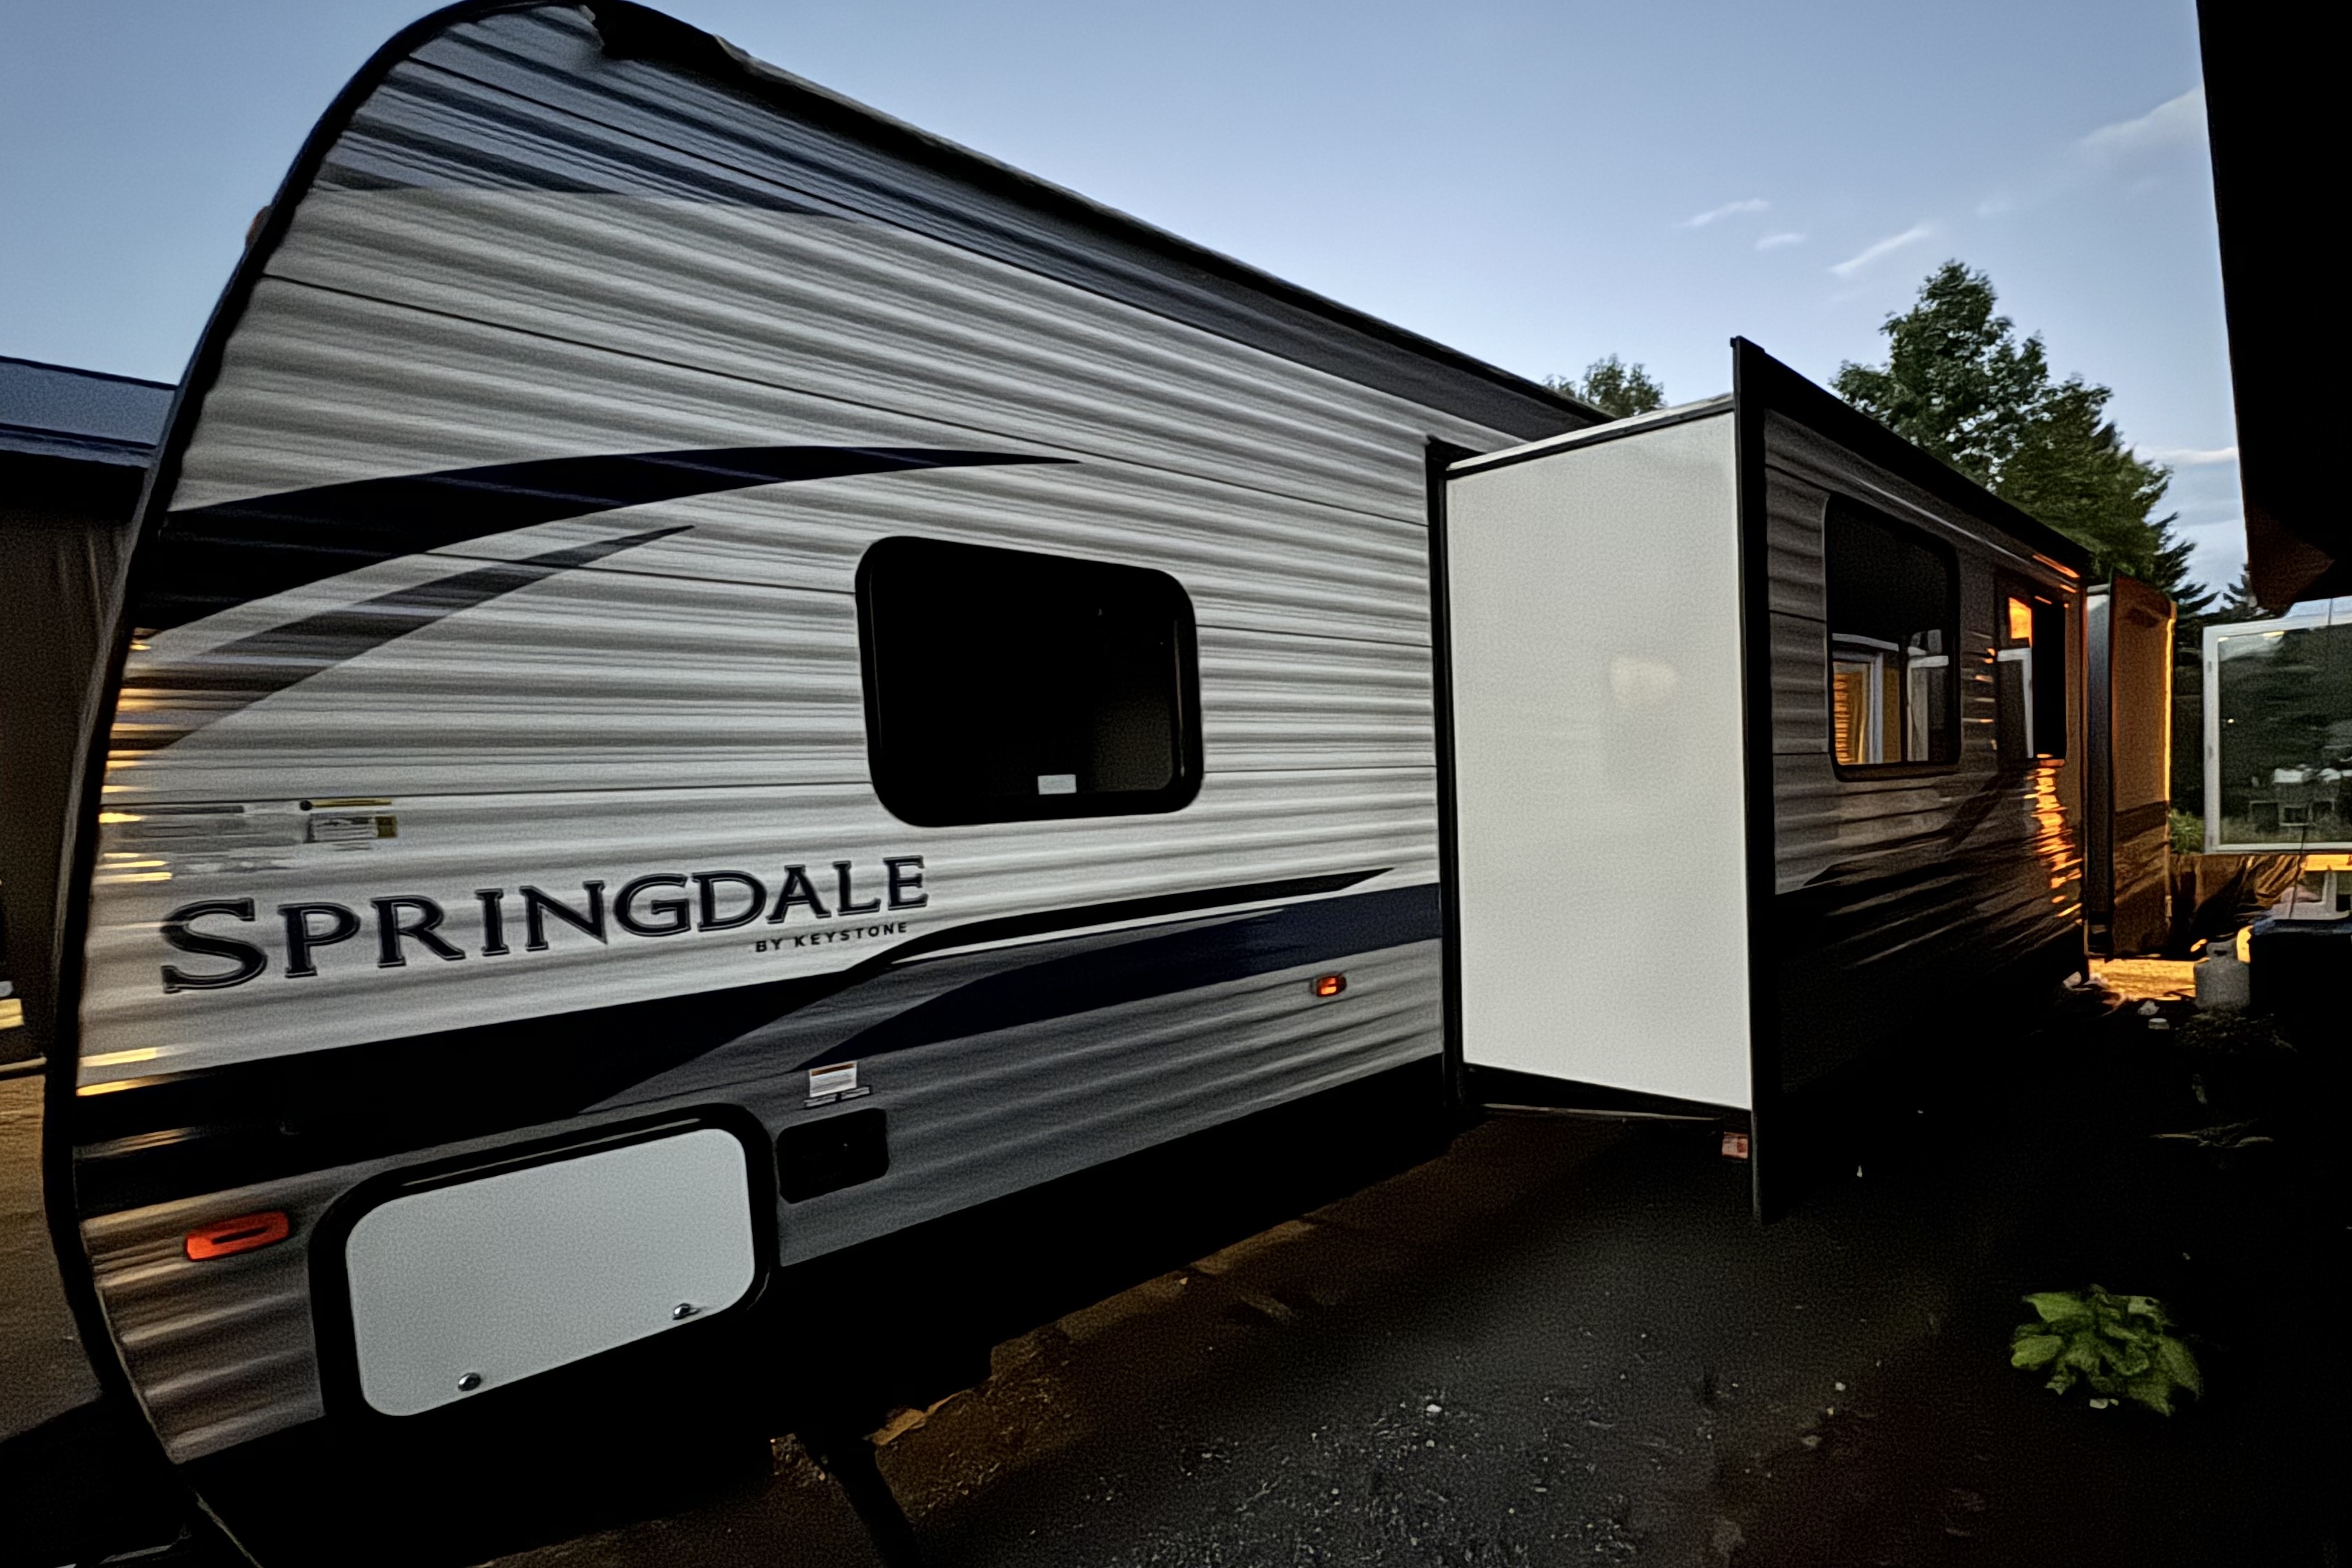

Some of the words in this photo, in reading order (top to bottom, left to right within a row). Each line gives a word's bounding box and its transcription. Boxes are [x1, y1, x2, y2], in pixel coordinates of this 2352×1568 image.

[161, 855, 928, 994] SPRINGDALE
[755, 939, 782, 952] BY
[795, 922, 907, 947] KEYSTONE
